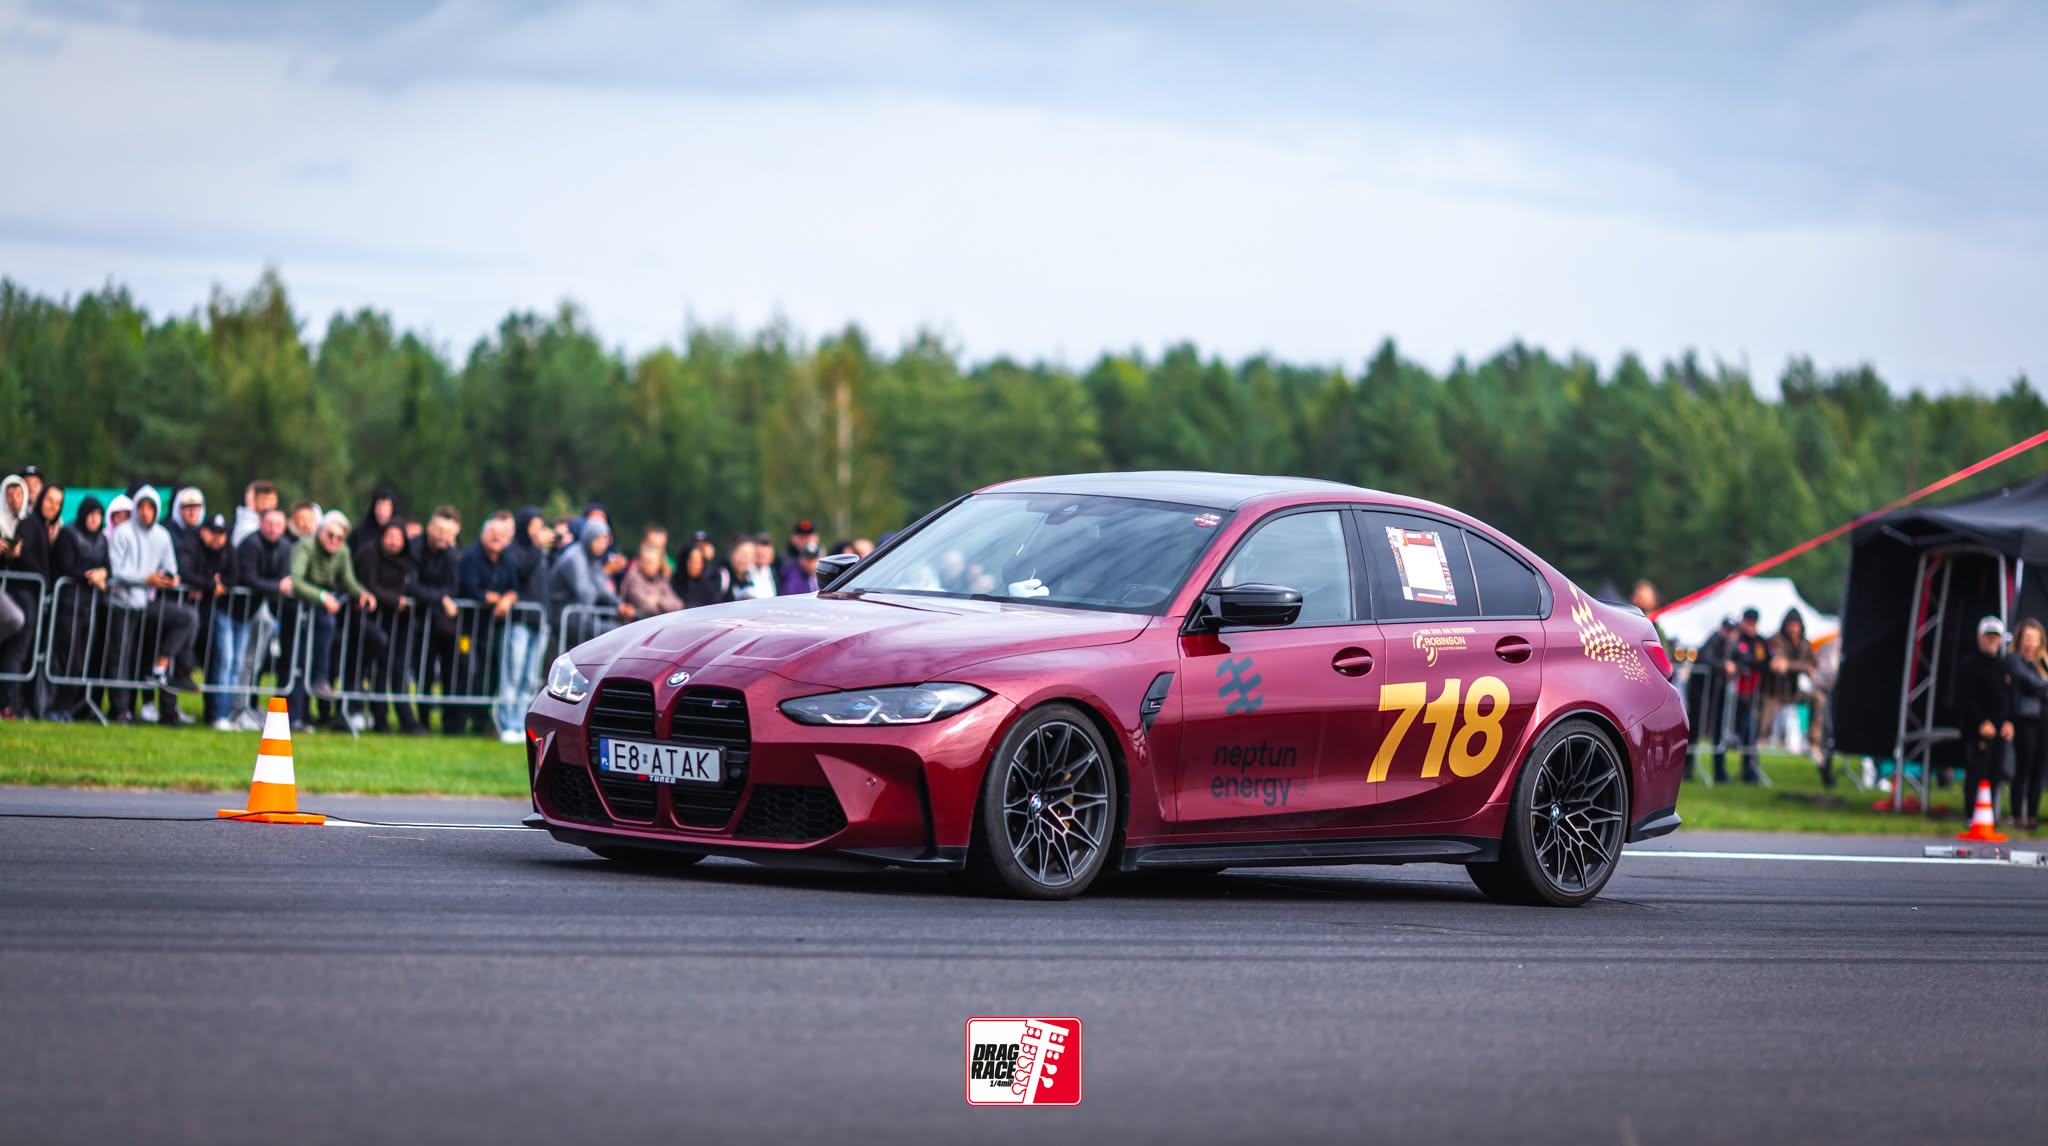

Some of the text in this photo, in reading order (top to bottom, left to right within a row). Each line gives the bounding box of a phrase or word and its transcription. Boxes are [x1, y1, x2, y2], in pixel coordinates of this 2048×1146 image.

[1424, 636, 1467, 646] ROBINSON
[1366, 675, 1511, 784] 718
[614, 743, 710, 779] E8 ATAK
[1213, 740, 1297, 775] neptun
[1210, 776, 1291, 807] energy
